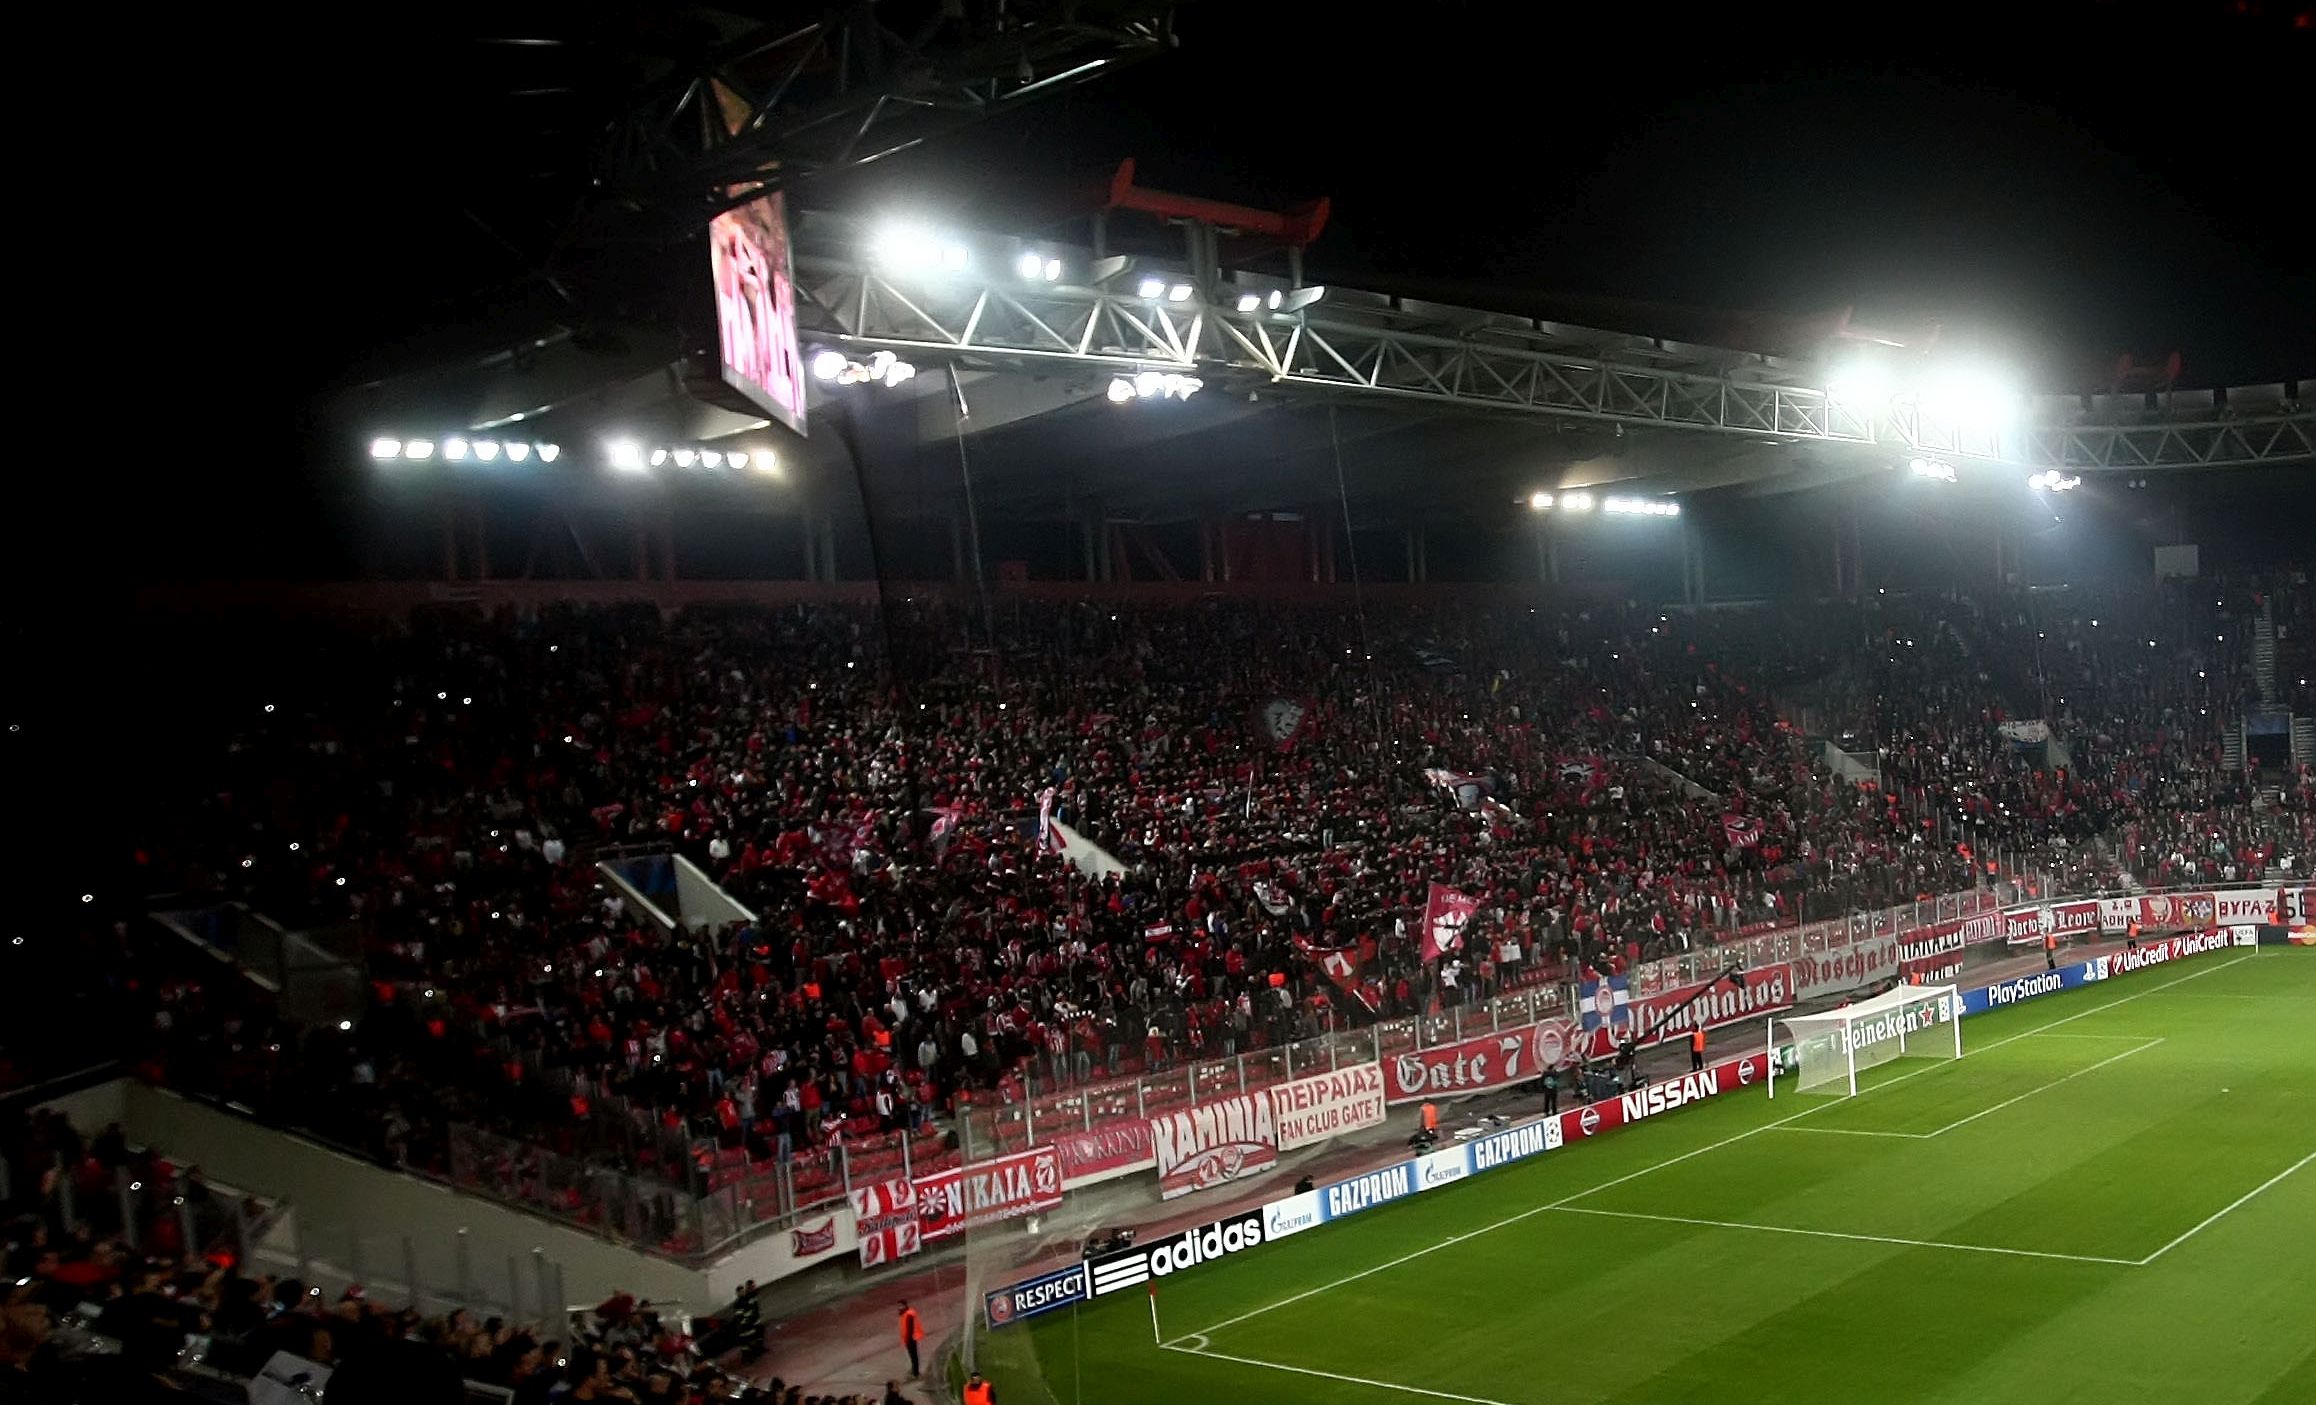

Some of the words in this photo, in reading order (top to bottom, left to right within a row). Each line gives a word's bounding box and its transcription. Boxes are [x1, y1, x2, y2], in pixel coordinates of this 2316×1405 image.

[2006, 918, 2038, 941] Porto
[2182, 929, 2229, 956] UniCredit
[1795, 942, 1897, 988] Moschato
[2123, 941, 2169, 971] UniCredit
[1988, 973, 2062, 1007] PlayStation
[1840, 1010, 1919, 1054] Heineken
[1396, 1051, 1488, 1094] Gate
[1499, 1034, 1523, 1077] 7
[1274, 1065, 1380, 1115] ΠΕΙΡΑΙΑΣ
[1621, 1069, 1719, 1123] NISSAN
[1279, 1118, 1303, 1142] FAN
[1306, 1108, 1339, 1135] CLUB
[1342, 1099, 1372, 1125] GATE
[1374, 1095, 1382, 1115] 7
[1473, 1124, 1545, 1170] GAZPROM
[944, 1164, 1032, 1218] NIKAIA
[1328, 1166, 1409, 1217] GAZPROM
[1150, 1218, 1262, 1277] adidas
[1015, 1273, 1085, 1312] RESPECT
